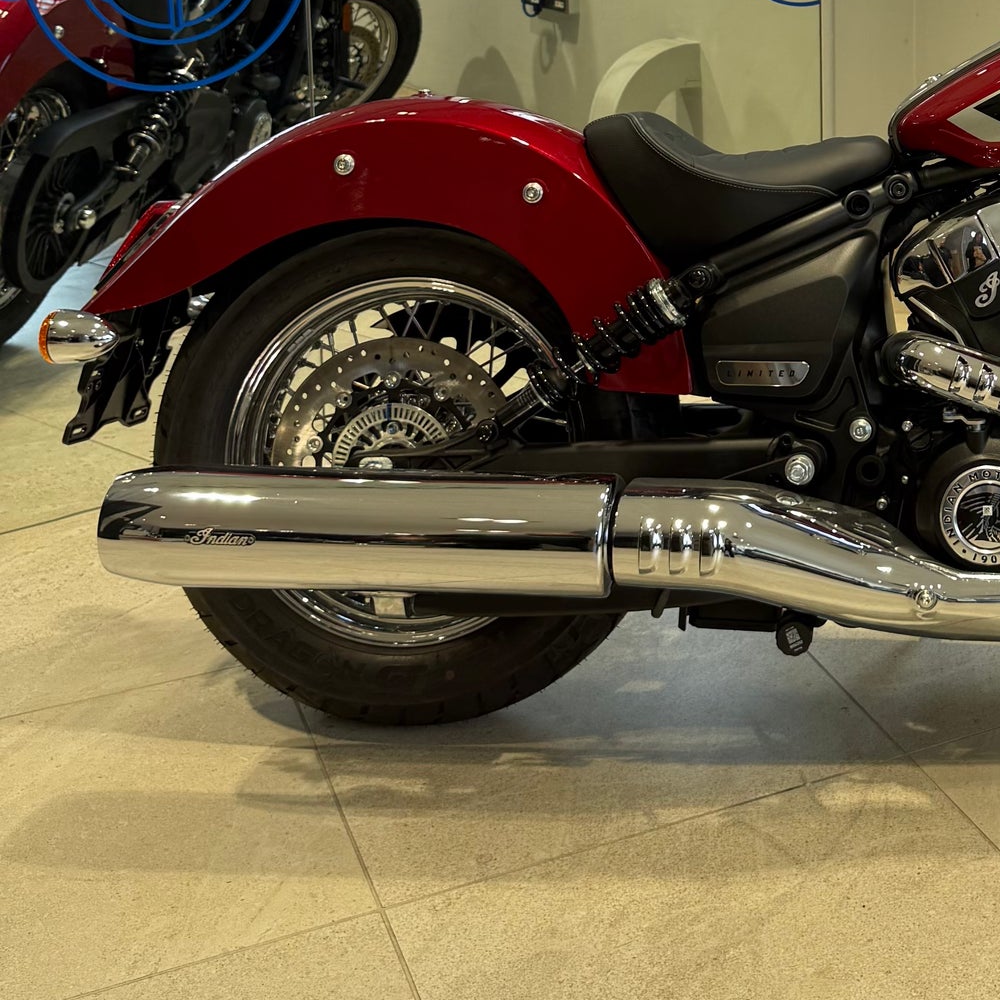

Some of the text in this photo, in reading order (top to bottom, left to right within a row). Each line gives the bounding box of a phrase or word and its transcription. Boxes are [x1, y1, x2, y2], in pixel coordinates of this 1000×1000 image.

[727, 369, 796, 378] LIMITED
[943, 482, 964, 546] INDIAN
[190, 527, 249, 546] Indian
[228, 591, 367, 680] DRAGON
